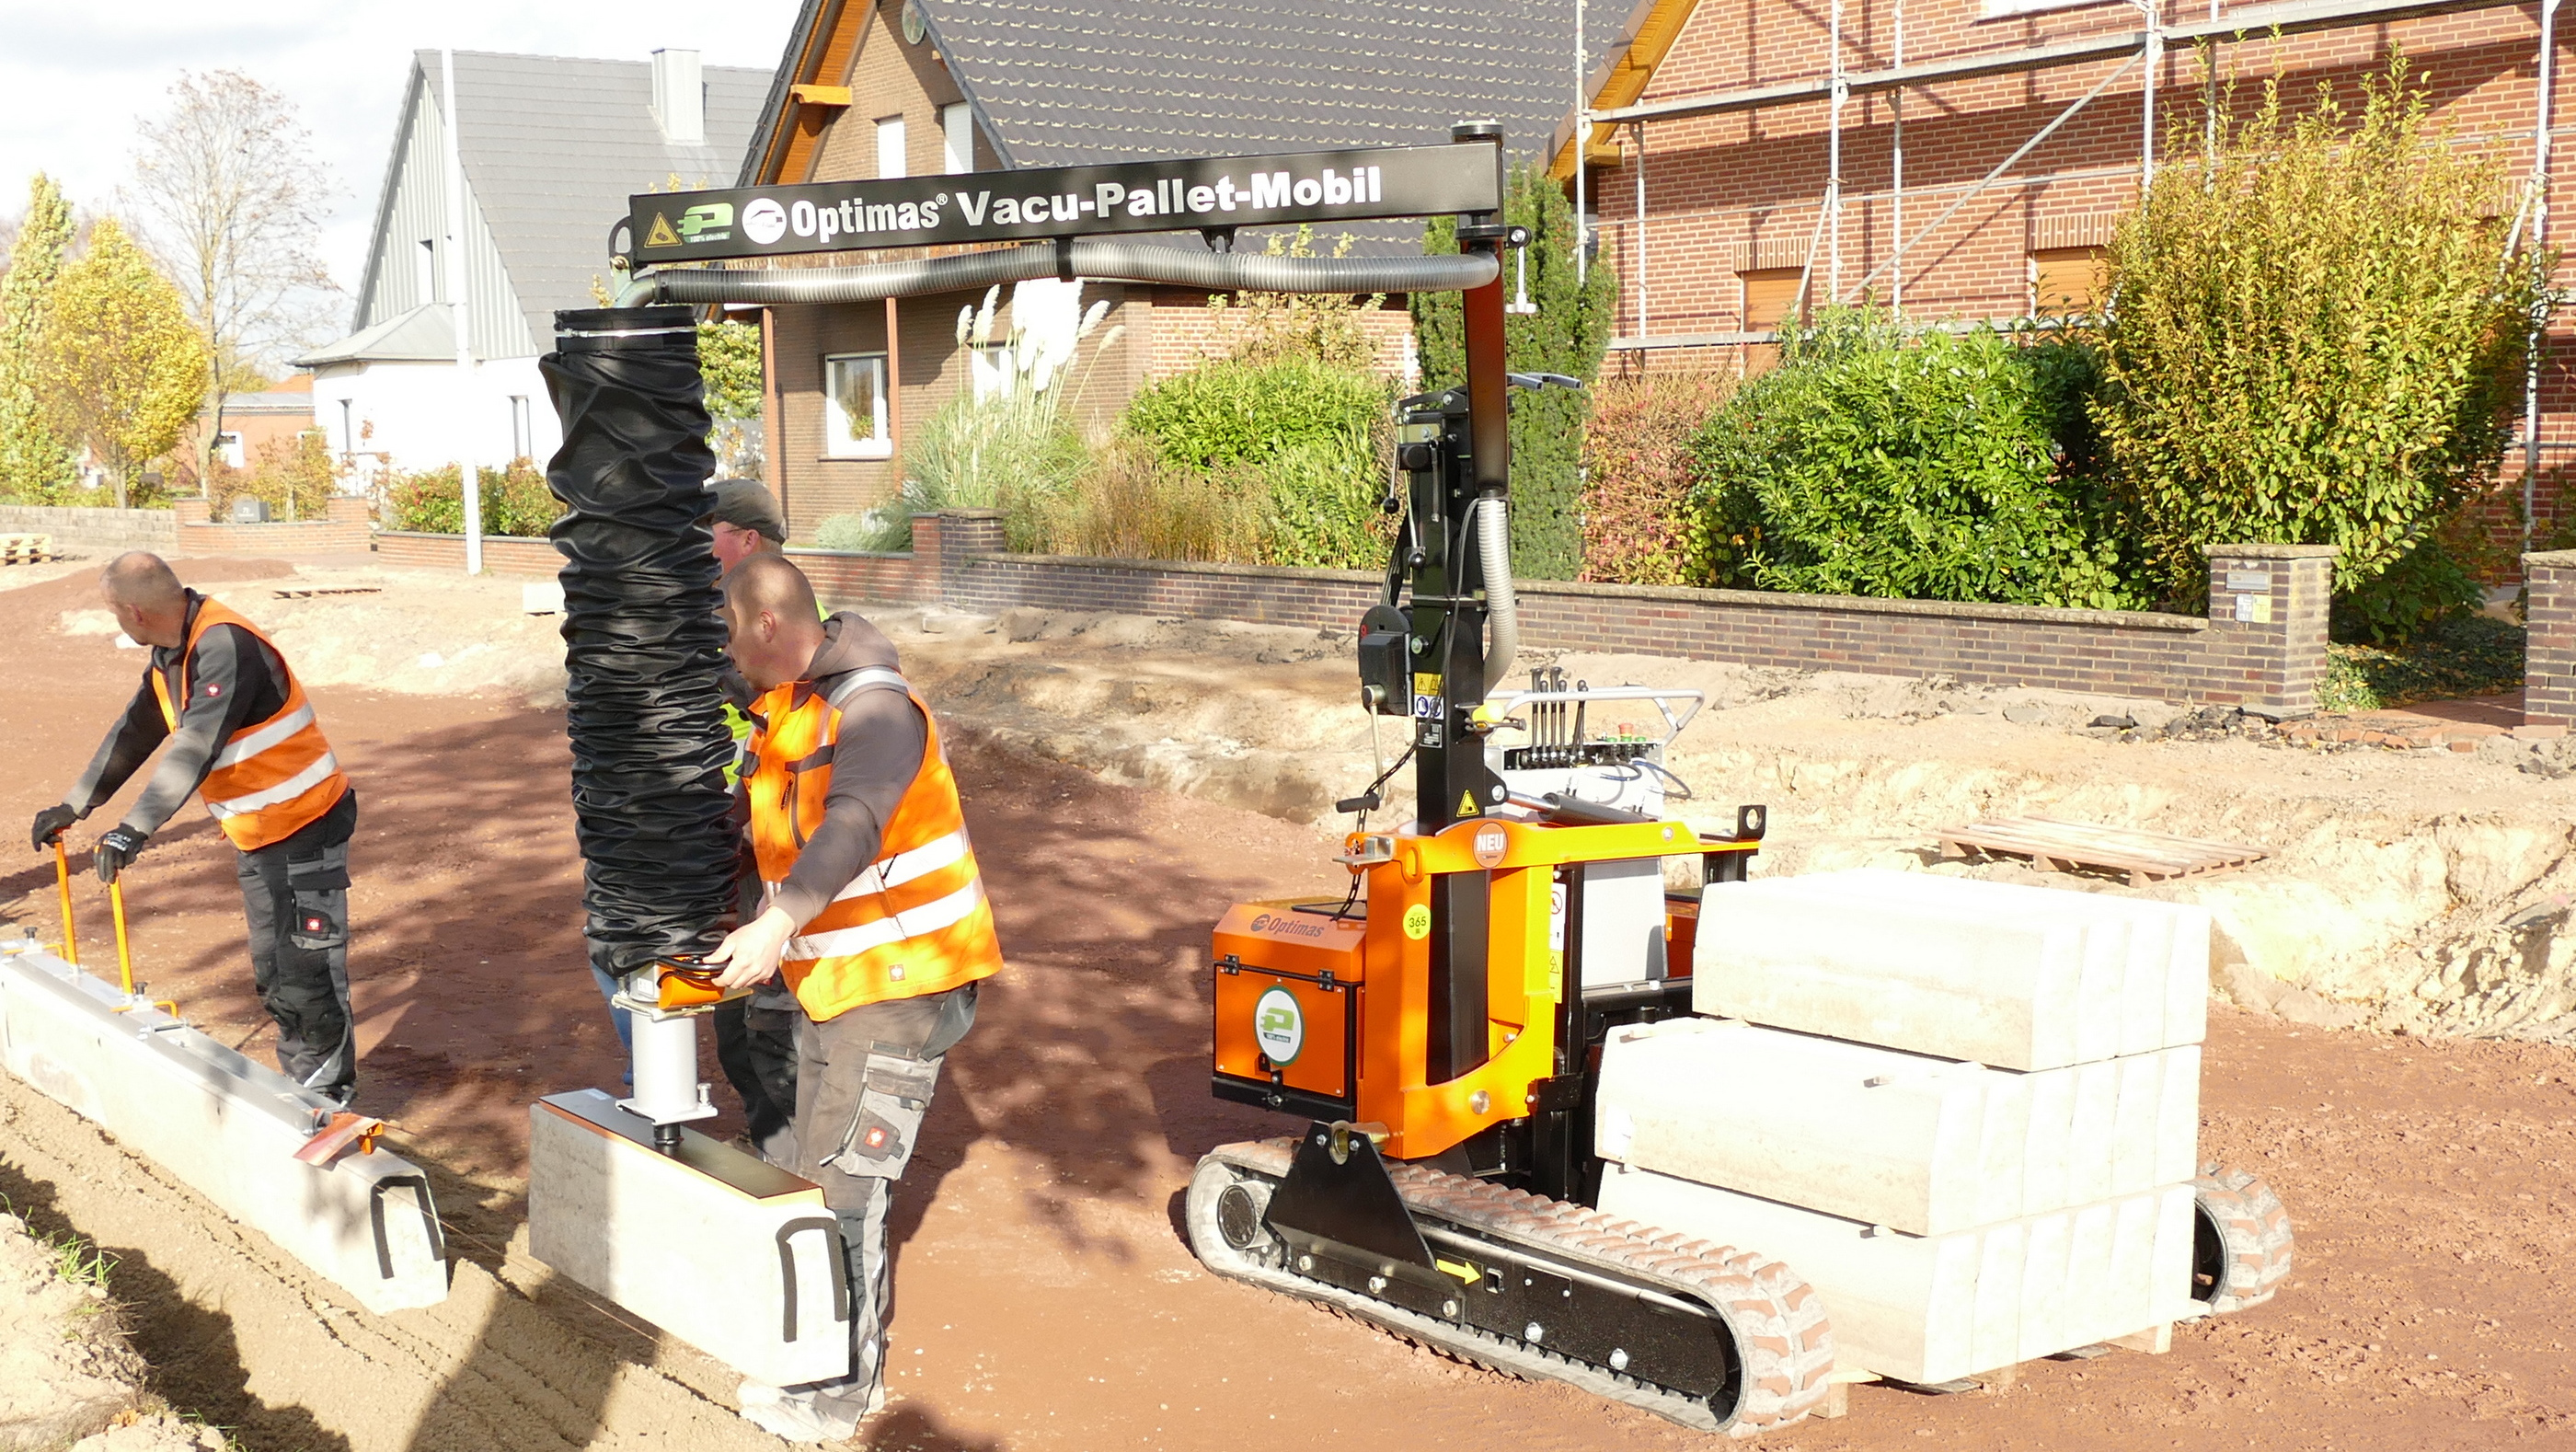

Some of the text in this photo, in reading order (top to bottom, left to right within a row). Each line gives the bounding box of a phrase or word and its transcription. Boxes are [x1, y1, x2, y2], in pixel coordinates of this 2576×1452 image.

[955, 166, 1382, 226] Vacu-Pallet-Mobil
[1477, 833, 1504, 852] NEU
[1268, 917, 1325, 938] Optimas
[1409, 916, 1427, 928] 365
